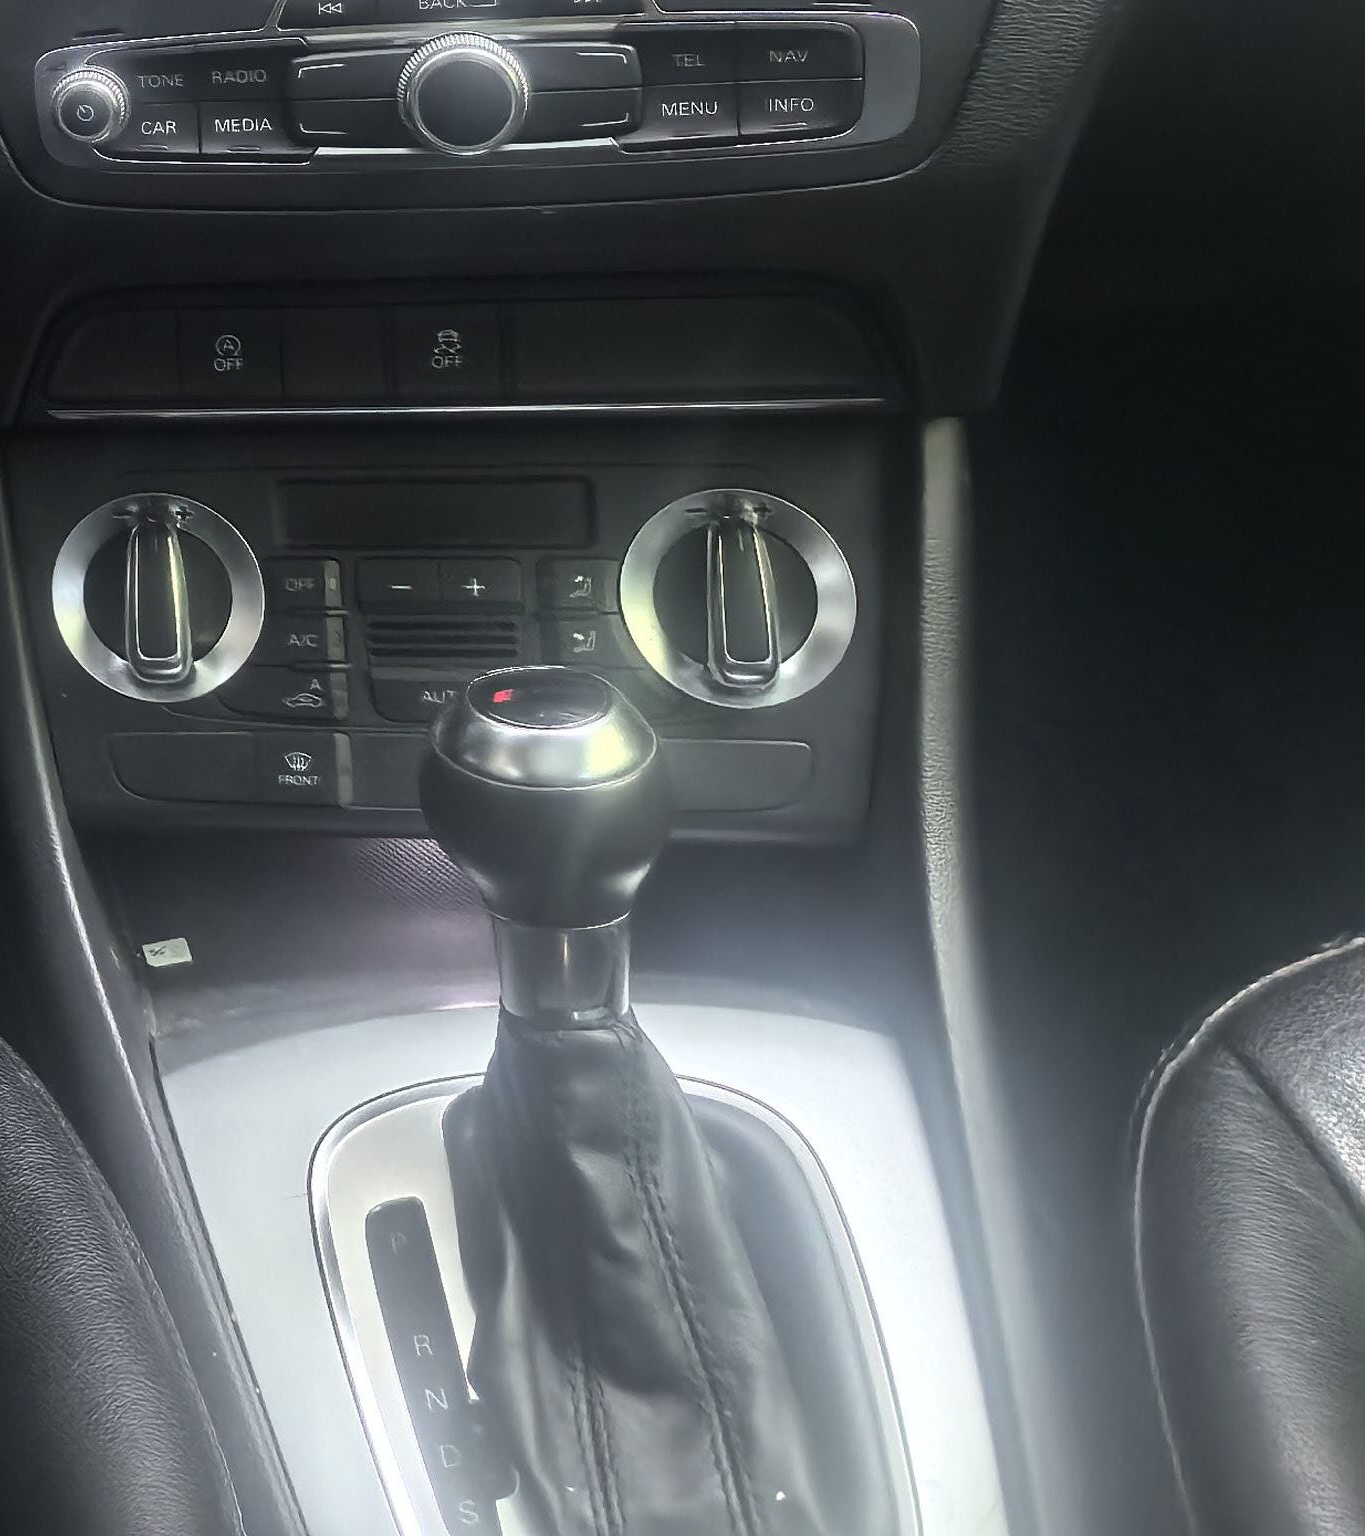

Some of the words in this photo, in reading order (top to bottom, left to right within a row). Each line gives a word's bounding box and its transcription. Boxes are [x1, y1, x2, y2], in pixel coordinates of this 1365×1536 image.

[671, 53, 705, 67] TEL
[769, 50, 809, 63] NAV
[138, 73, 185, 88] TONE
[211, 69, 267, 85] RADIO
[662, 101, 718, 117] MENU
[769, 97, 815, 112] INFO
[141, 120, 177, 135] CAR
[214, 117, 273, 133] MEDIA
[214, 358, 244, 371] OFF
[431, 355, 463, 369] OFF
[285, 577, 316, 592] OFF
[287, 633, 319, 648] A/C
[423, 690, 459, 704] AUT
[278, 774, 321, 786] FRONT
[413, 1334, 433, 1356] R
[425, 1387, 449, 1410] N
[439, 1444, 462, 1468] D
[458, 1500, 480, 1524] S
